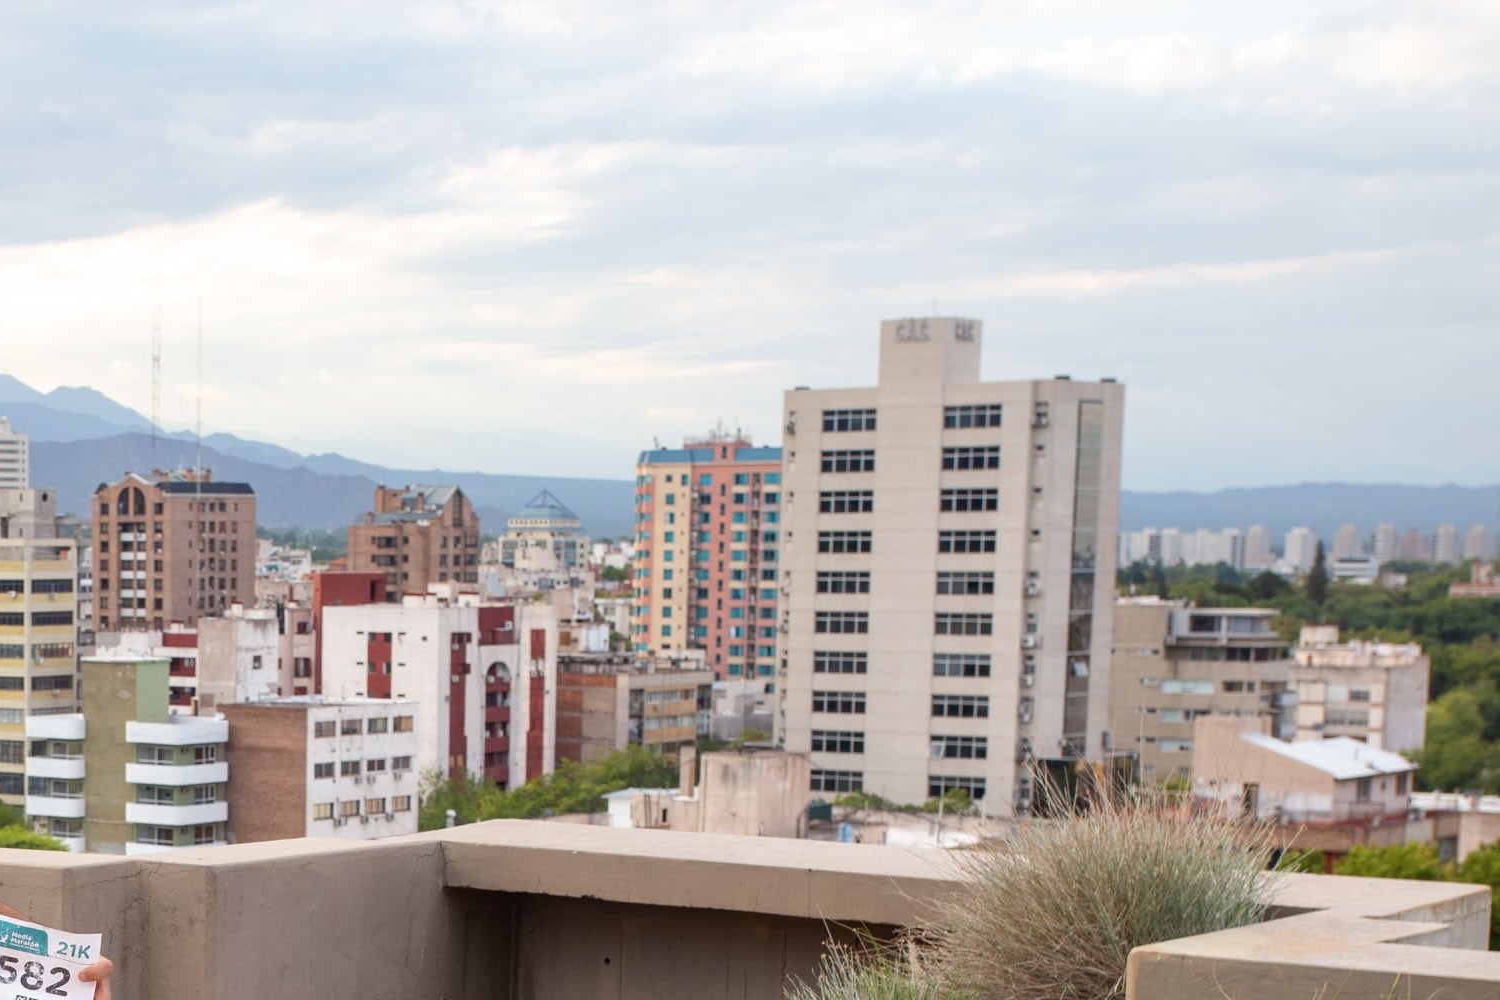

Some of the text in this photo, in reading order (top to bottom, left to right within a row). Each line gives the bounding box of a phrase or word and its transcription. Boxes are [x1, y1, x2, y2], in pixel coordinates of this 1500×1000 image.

[11, 931, 32, 941] Media
[10, 937, 39, 948] Maratón
[56, 941, 91, 960] 21K
